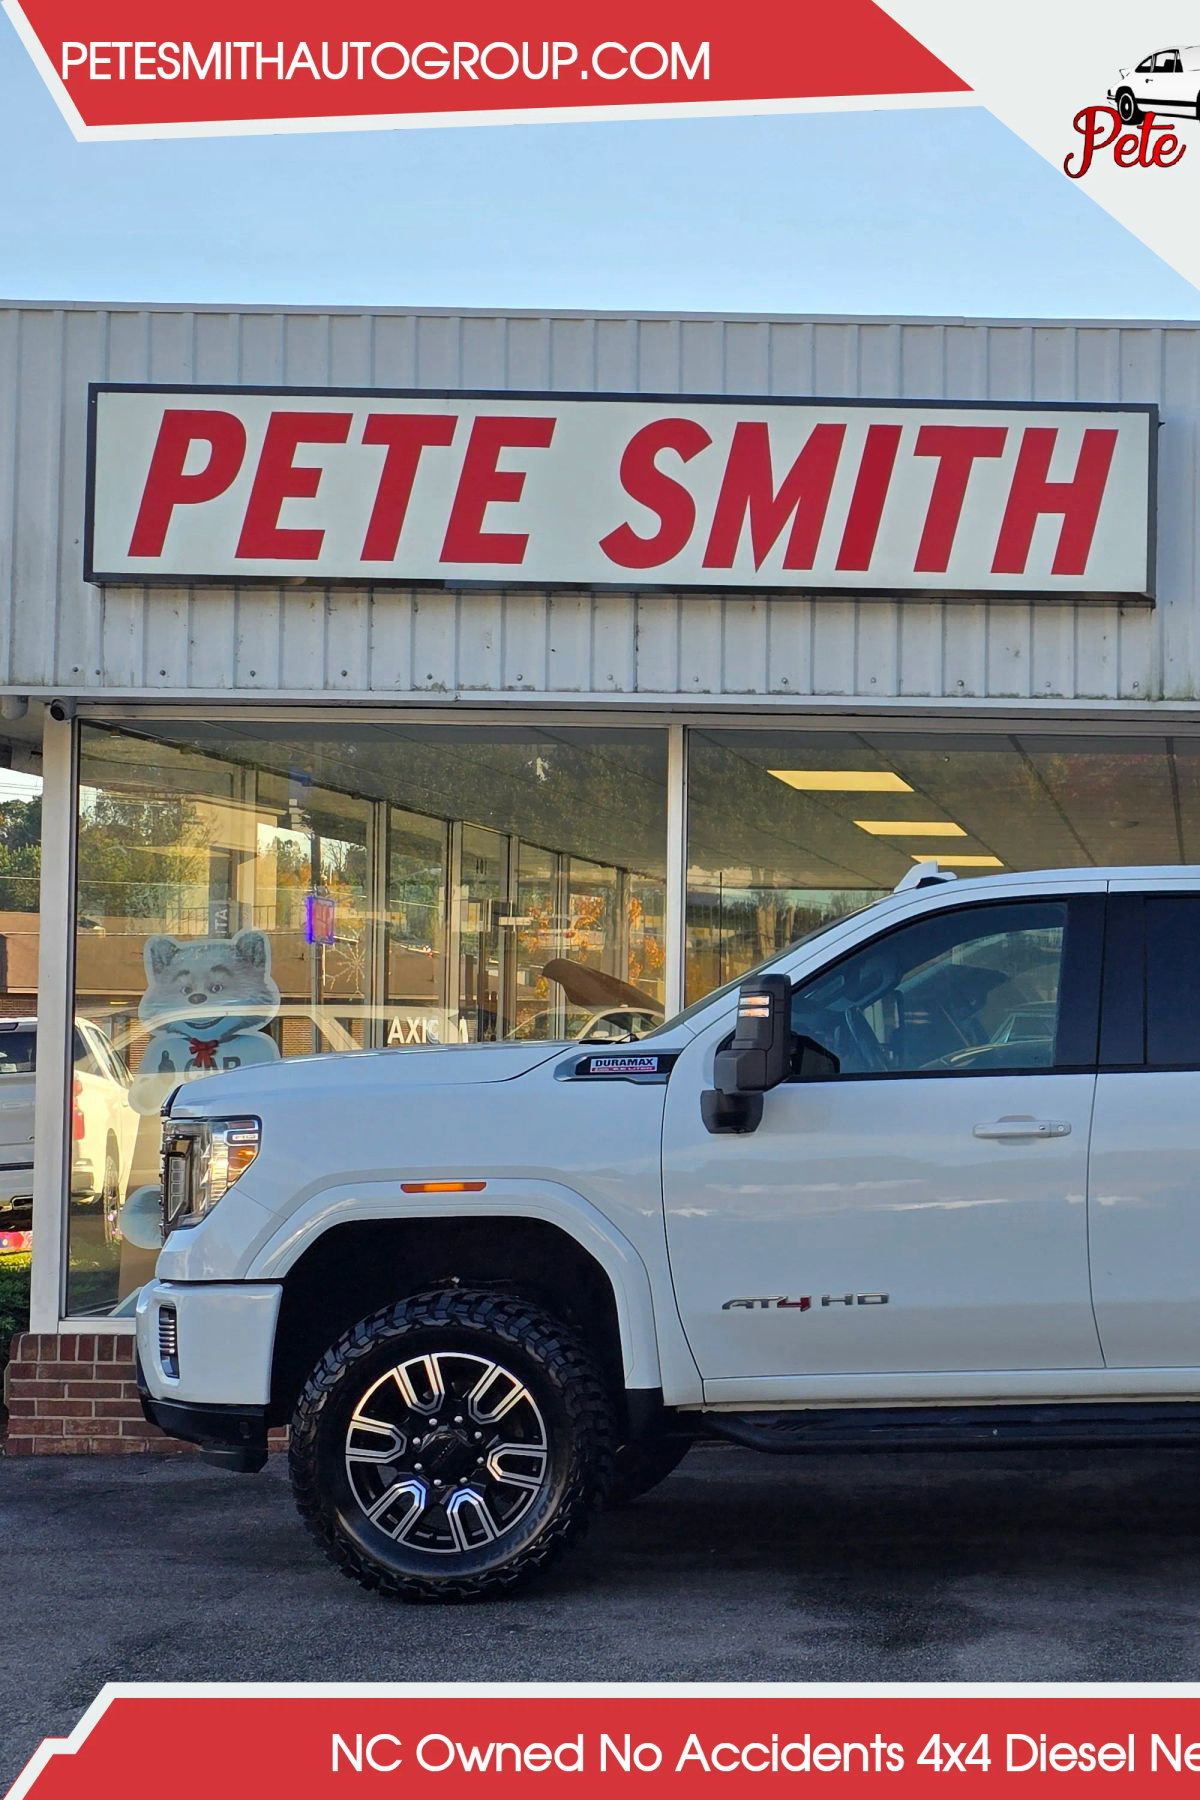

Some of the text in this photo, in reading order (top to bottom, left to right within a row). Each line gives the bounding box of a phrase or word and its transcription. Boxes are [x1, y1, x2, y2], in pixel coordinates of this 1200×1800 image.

[128, 408, 1118, 575] PETE SMITH
[595, 1058, 654, 1067] DURAMAX
[721, 1293, 889, 1313] AT4 HD
